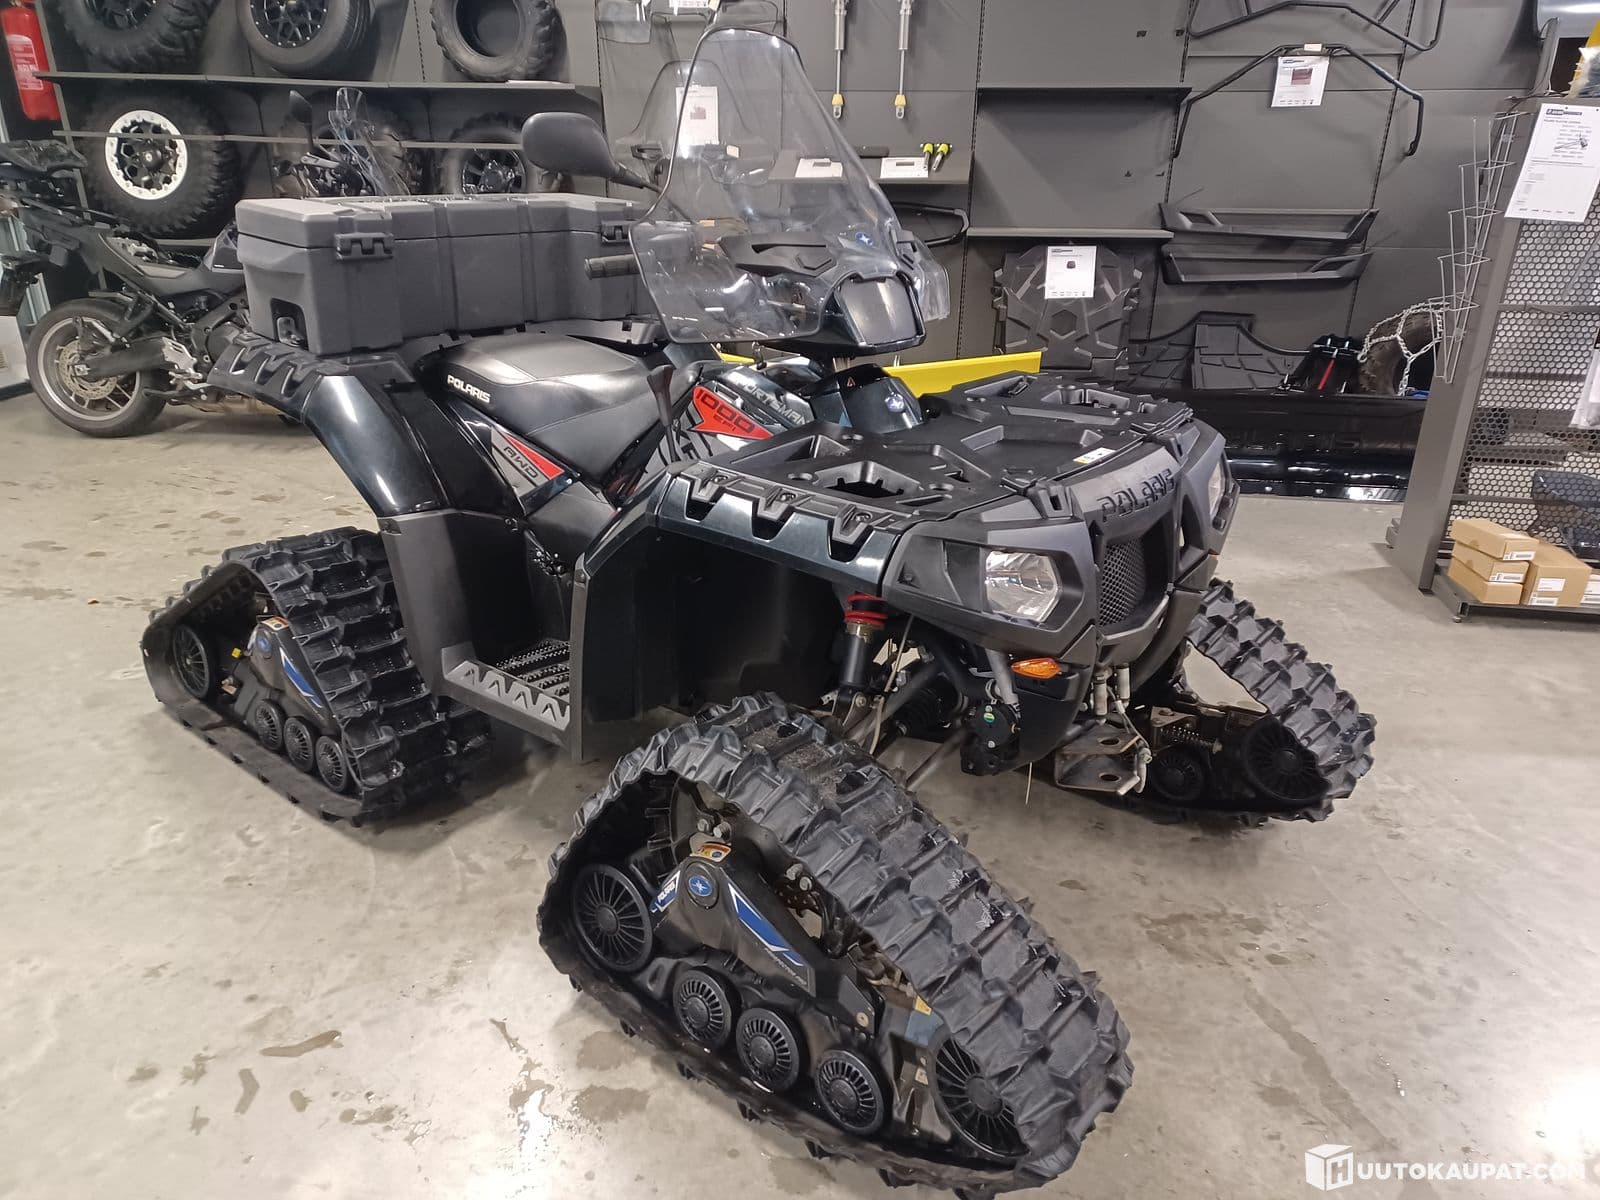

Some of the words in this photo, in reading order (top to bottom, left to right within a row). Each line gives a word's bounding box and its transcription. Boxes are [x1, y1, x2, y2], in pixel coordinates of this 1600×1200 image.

[447, 374, 491, 403] POLARIS
[728, 371, 808, 426] PORTSMAN
[696, 389, 755, 433] 1000
[503, 446, 539, 479] AWD
[1096, 468, 1175, 522] POLARIS
